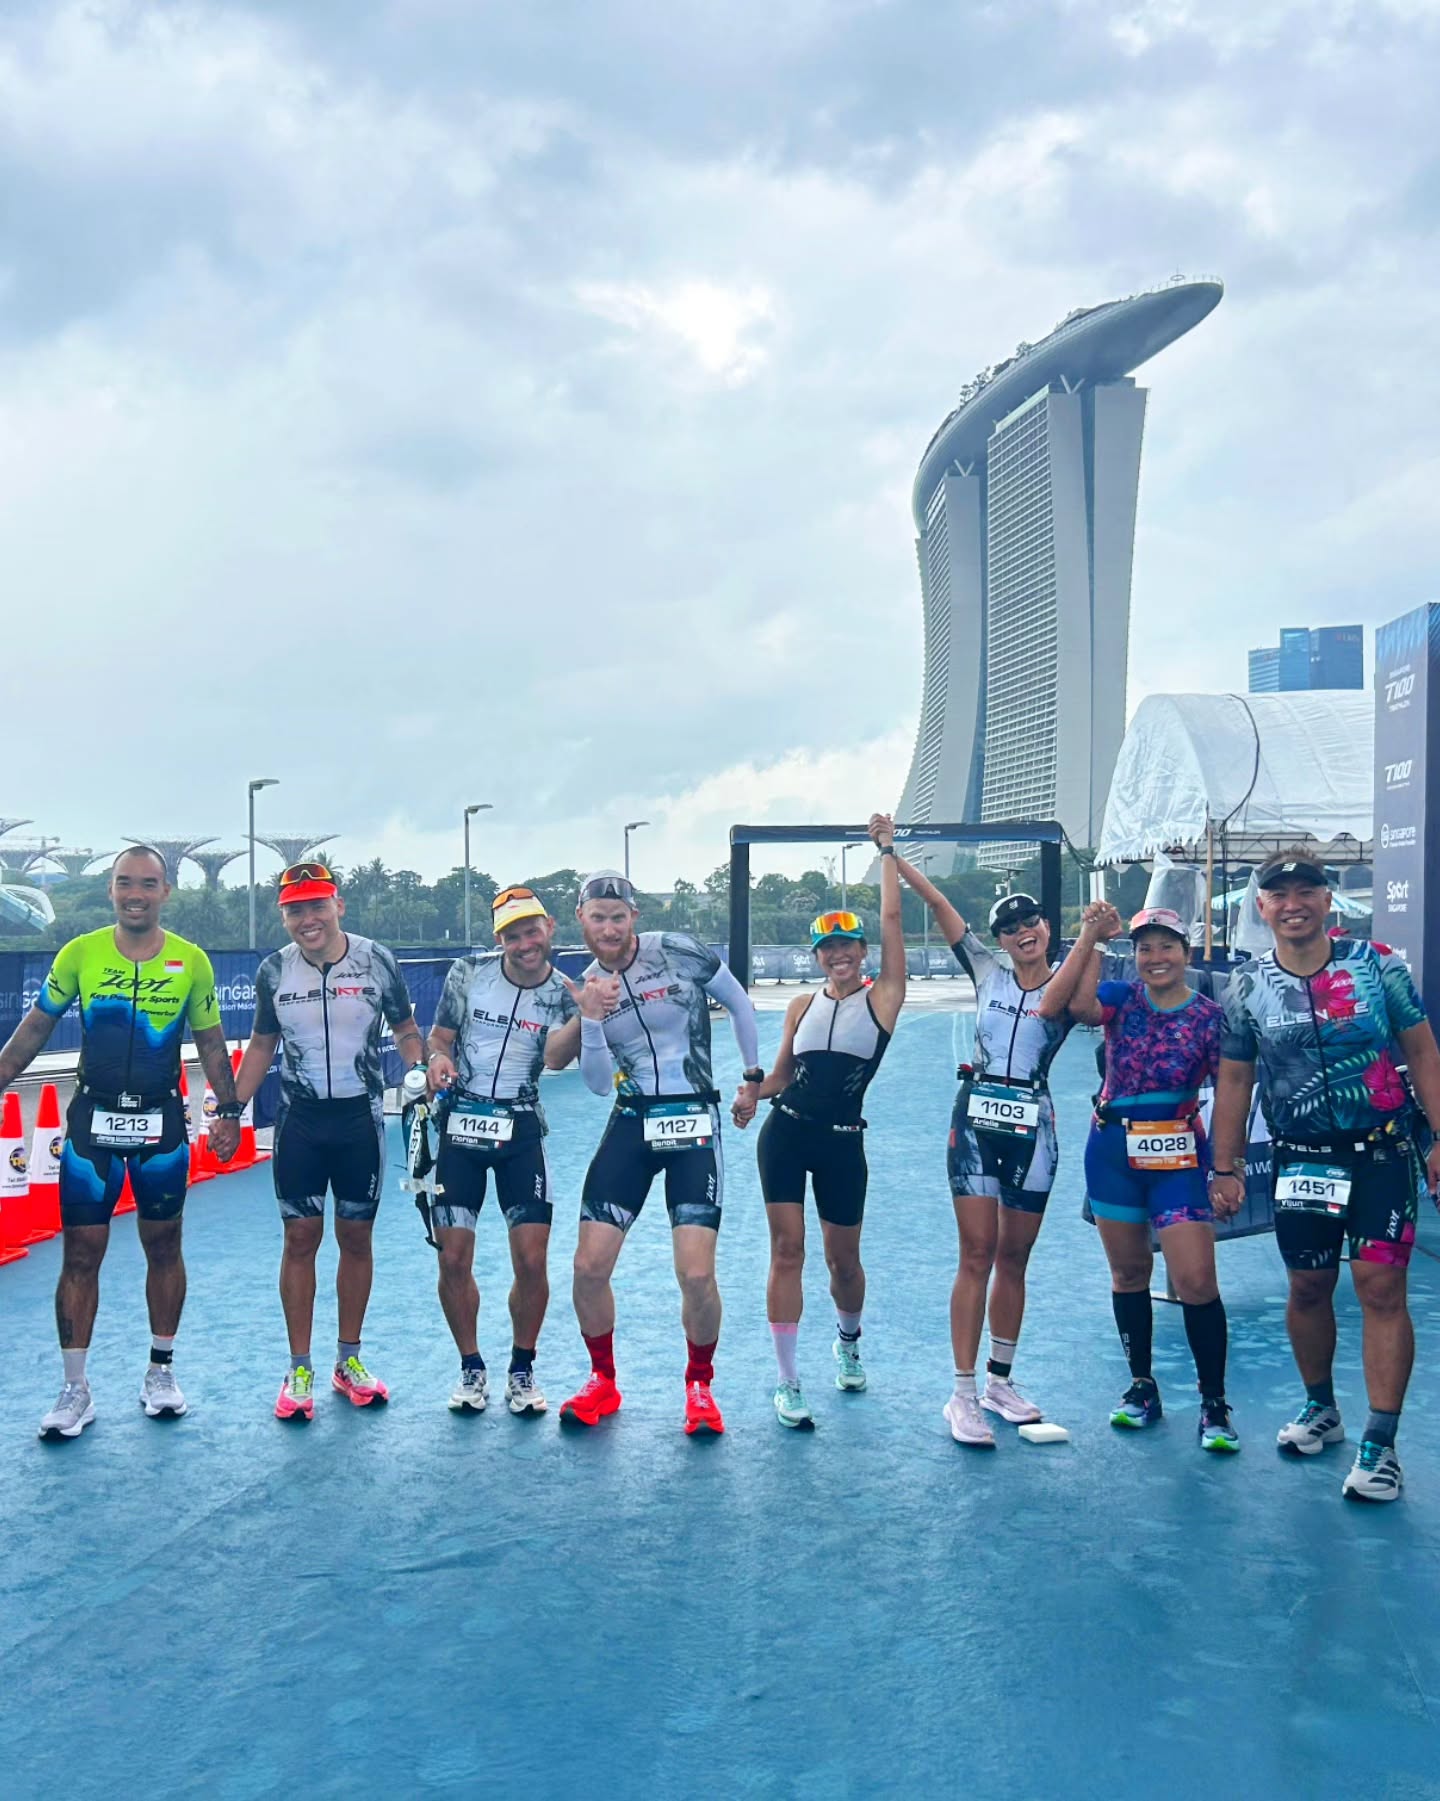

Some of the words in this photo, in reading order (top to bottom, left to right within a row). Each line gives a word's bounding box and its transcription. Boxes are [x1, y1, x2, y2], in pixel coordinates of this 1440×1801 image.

[1384, 673, 1416, 703] T100
[1384, 760, 1413, 783] T100
[892, 828, 912, 837] 00
[1386, 880, 1409, 902] Sport
[102, 967, 126, 976] TEAM
[981, 1101, 1025, 1119] 1103
[105, 1117, 148, 1131] 1213
[460, 1118, 499, 1134] 1144
[657, 1119, 697, 1134] 1127
[973, 1118, 999, 1128] Arielle
[451, 1136, 478, 1145] Florian
[1138, 1137, 1187, 1151] 4028
[1289, 1181, 1336, 1197] 1451
